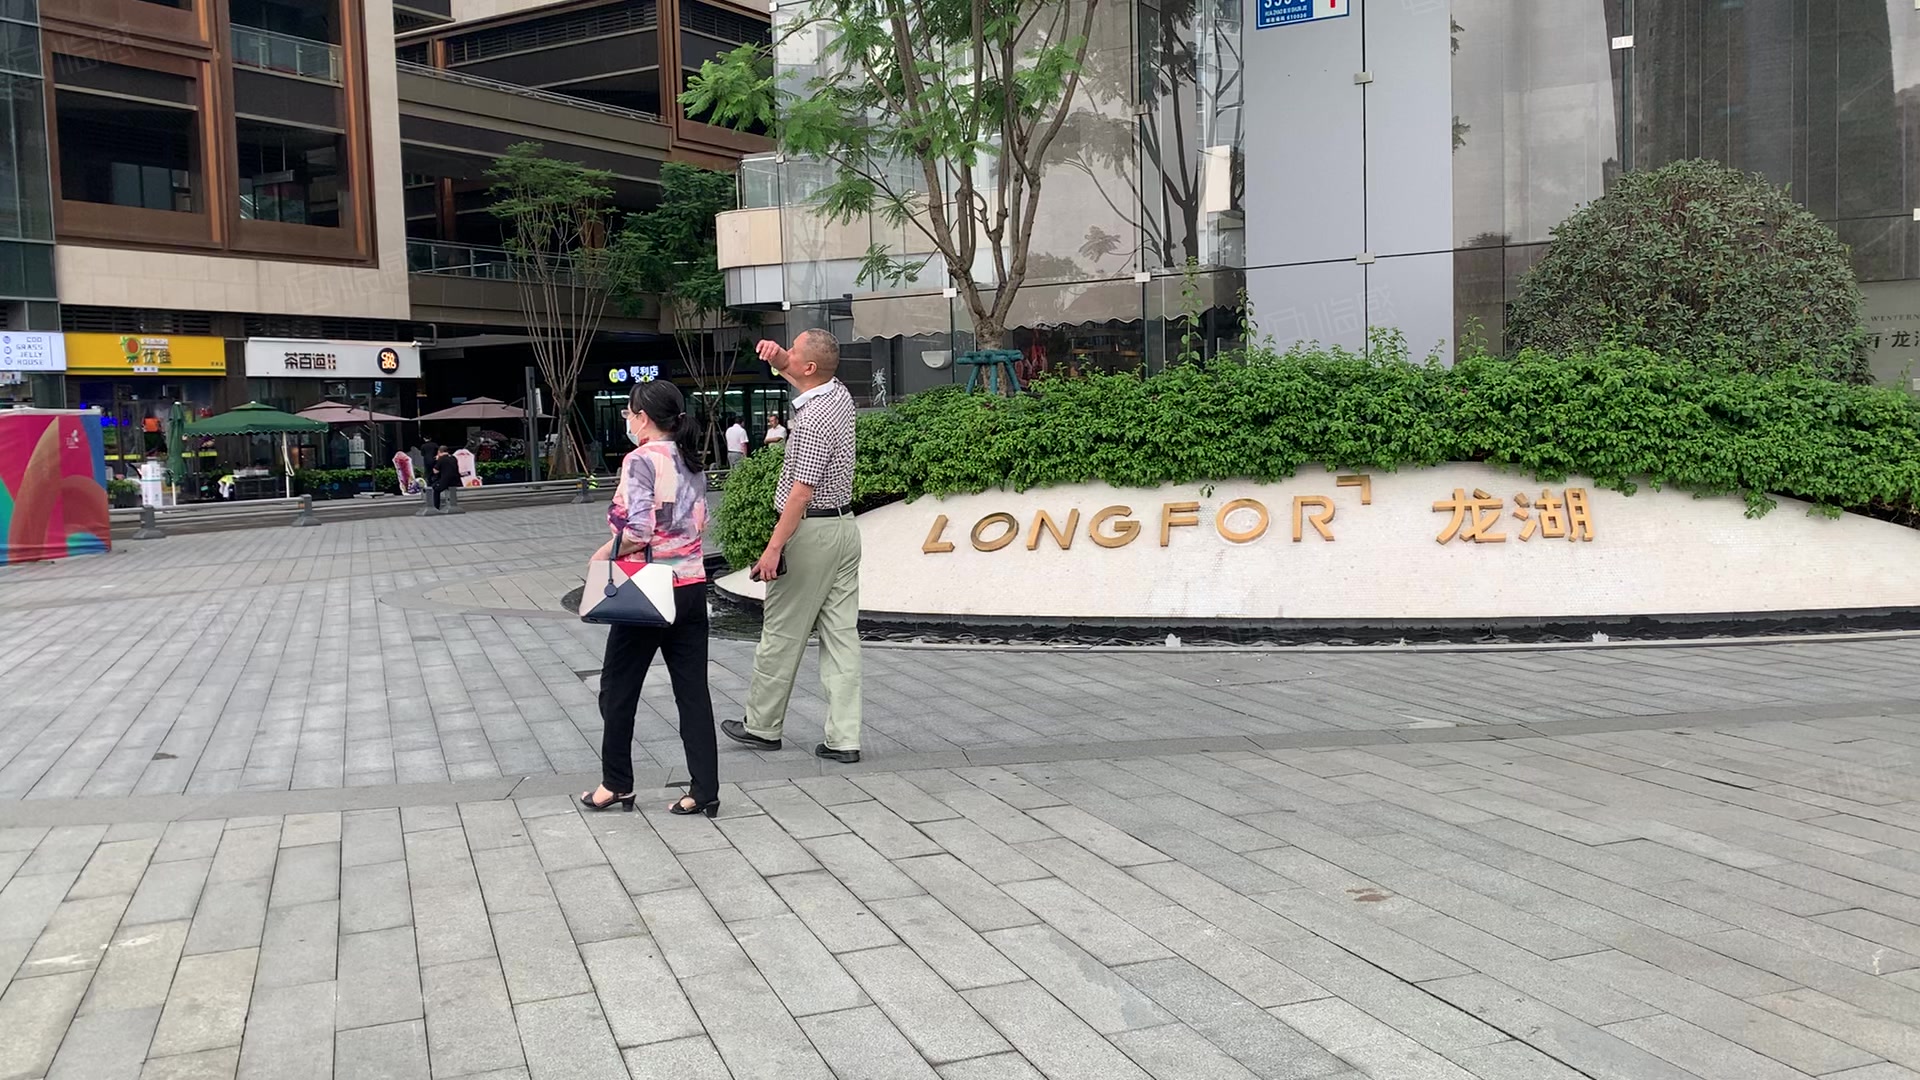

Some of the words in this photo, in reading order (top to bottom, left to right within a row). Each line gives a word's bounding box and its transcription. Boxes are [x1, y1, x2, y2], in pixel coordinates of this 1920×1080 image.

[284, 352, 326, 370] 茶百道
[922, 494, 1335, 554] LONGFOR
[1432, 487, 1594, 546] 龙湖
